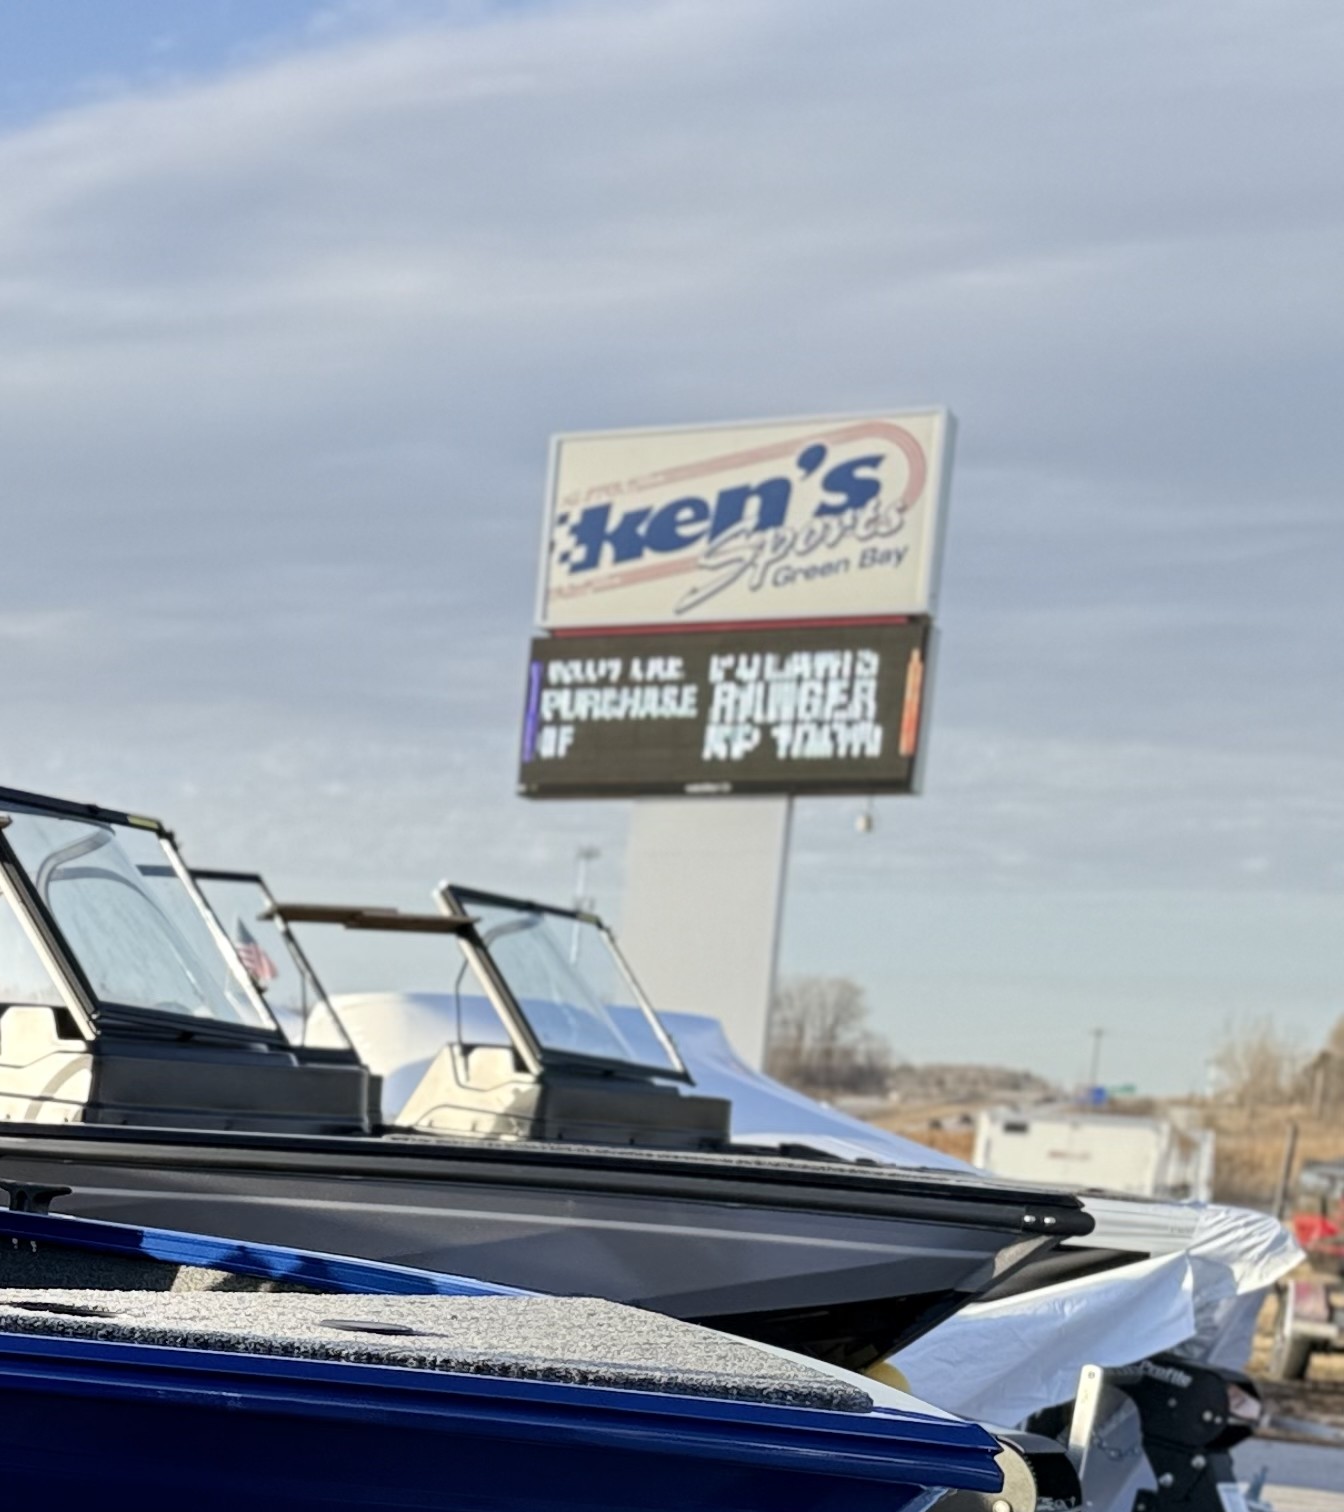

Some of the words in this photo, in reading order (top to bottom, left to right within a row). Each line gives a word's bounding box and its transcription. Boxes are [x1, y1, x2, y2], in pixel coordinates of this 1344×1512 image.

[558, 443, 886, 575] ken's
[771, 560, 850, 588] Green
[859, 545, 908, 569] Bay
[540, 684, 699, 721] PURCHASE
[709, 679, 878, 724] RANGER
[536, 725, 576, 760] OF
